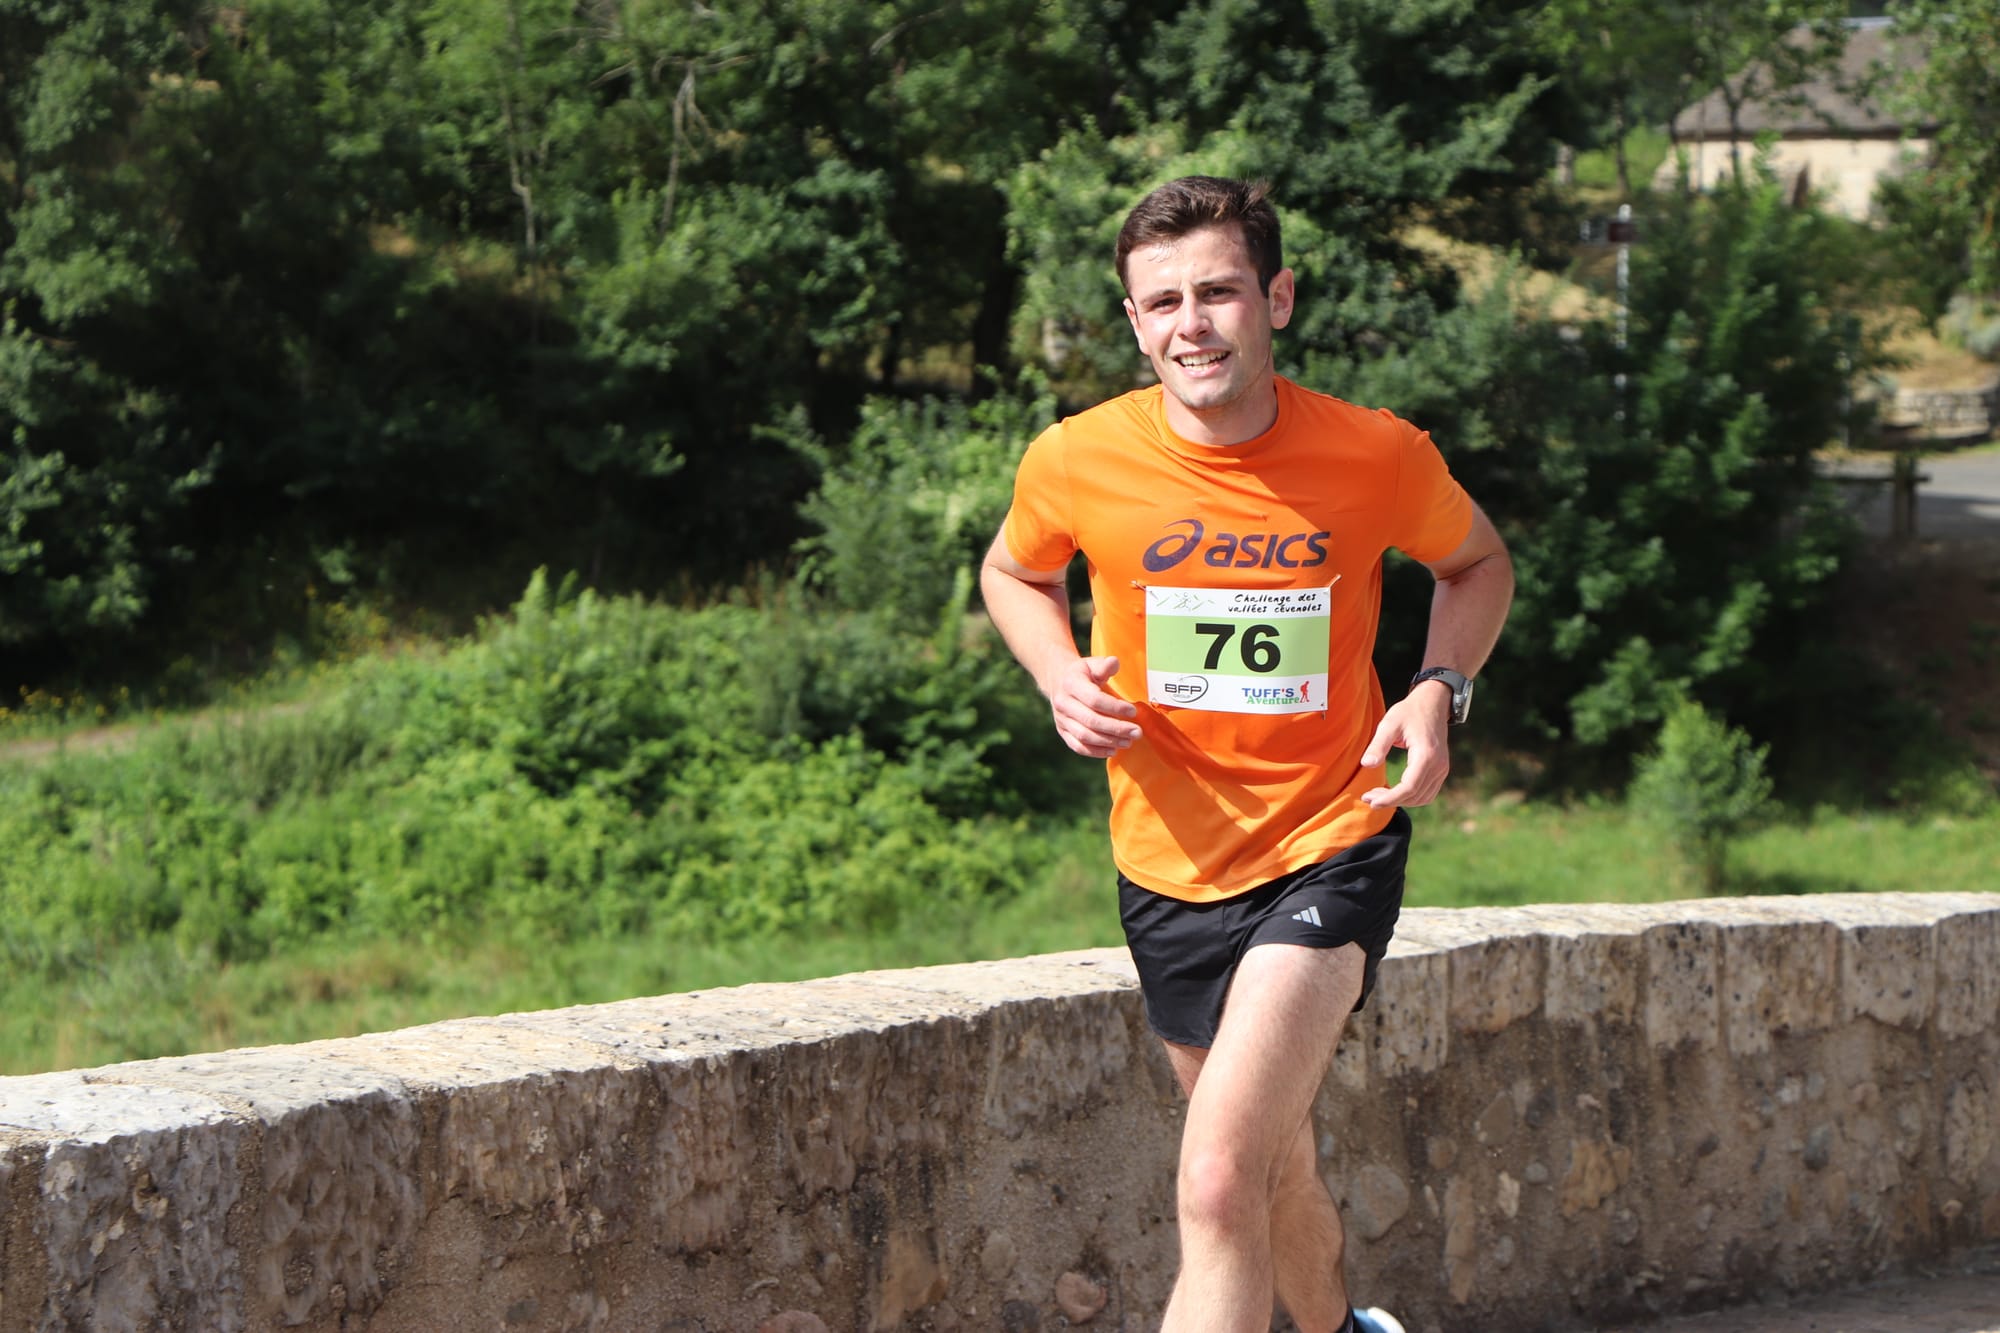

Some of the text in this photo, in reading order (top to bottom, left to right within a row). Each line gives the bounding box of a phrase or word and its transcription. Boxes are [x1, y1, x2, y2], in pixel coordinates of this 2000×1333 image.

[1234, 593, 1316, 605] Challenge des
[1228, 603, 1322, 613] vallées cévenoles
[1195, 623, 1281, 673] 76
[1165, 683, 1202, 695] BFP
[1241, 687, 1295, 698] TUFF'S
[1247, 695, 1300, 705] Aventure
